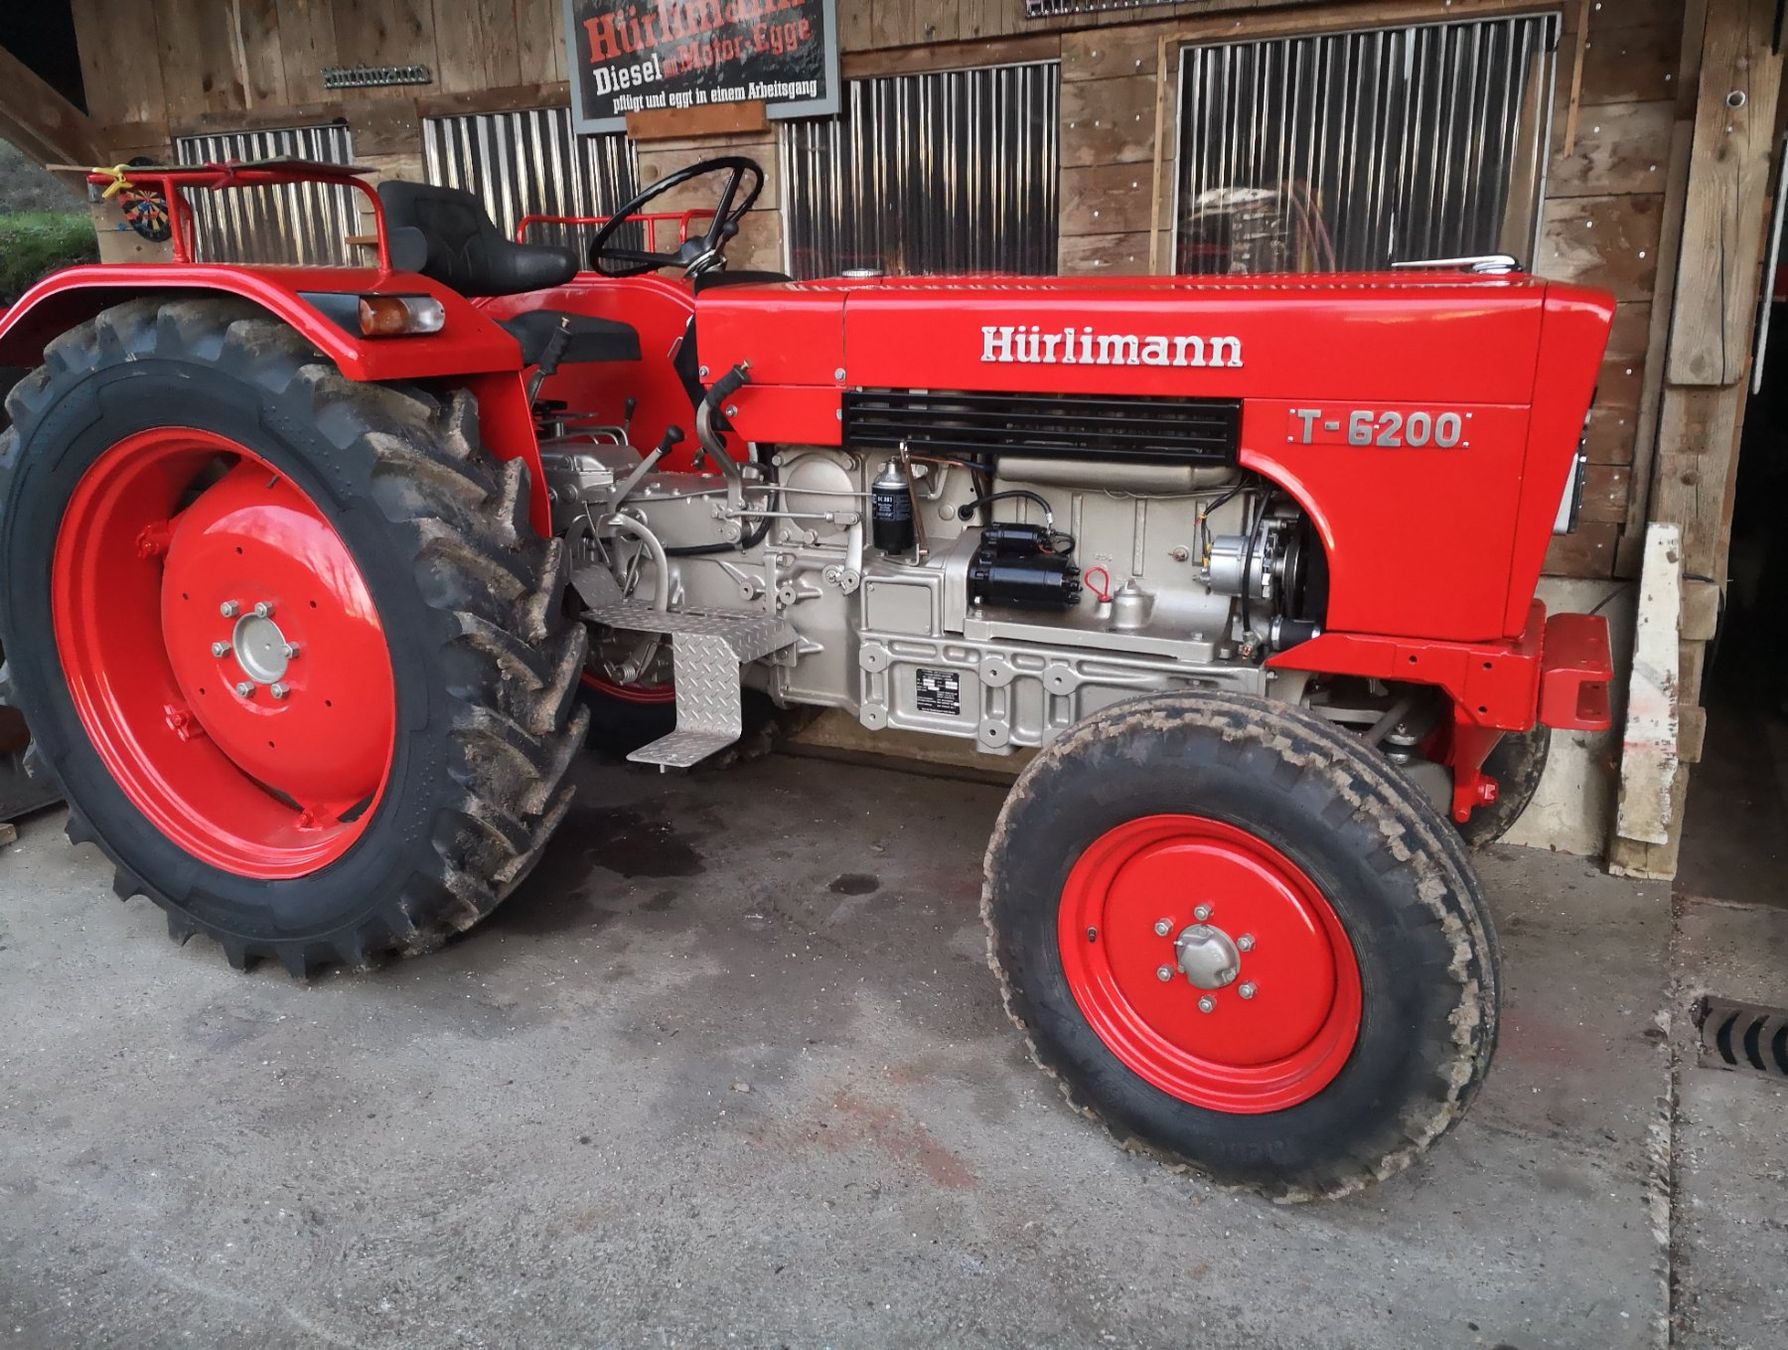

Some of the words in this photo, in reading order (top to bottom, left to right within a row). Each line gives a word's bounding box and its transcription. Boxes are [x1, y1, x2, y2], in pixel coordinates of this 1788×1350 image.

[593, 52, 662, 96] Diesel
[612, 94, 644, 115] pflügt
[645, 90, 667, 109] und
[669, 89, 694, 109] eggt
[695, 87, 708, 104] in
[710, 85, 746, 103] einem
[747, 80, 817, 100] Arbeitsgang
[981, 326, 1244, 368] Hürlimann
